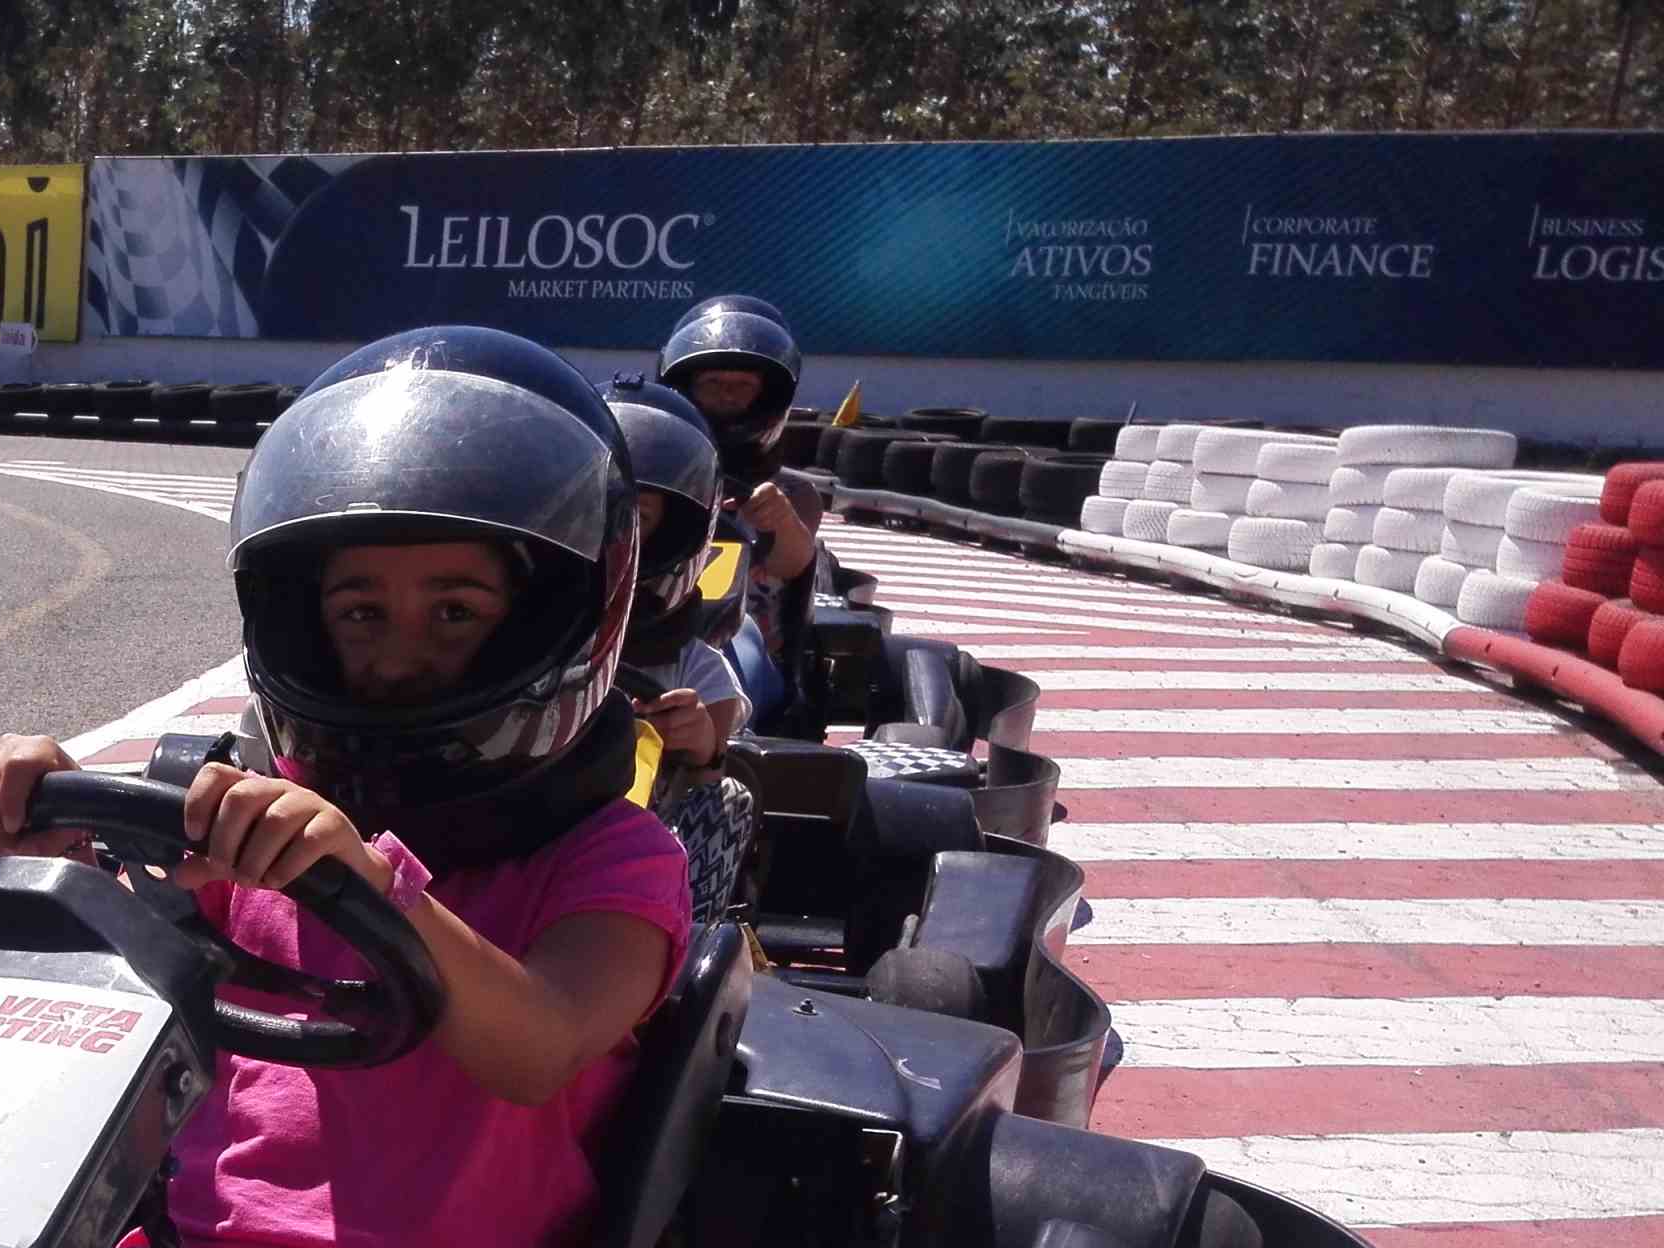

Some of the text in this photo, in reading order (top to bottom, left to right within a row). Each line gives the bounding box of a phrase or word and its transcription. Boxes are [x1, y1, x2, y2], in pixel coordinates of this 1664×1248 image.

[400, 205, 699, 269] LEILOSOC
[1252, 216, 1377, 236] CORPORATE
[1541, 217, 1644, 237] BUSINESS
[1009, 244, 1153, 278] ATIVOS
[1247, 242, 1436, 278] FINANCE
[507, 280, 695, 300] MARKET PARTNERS
